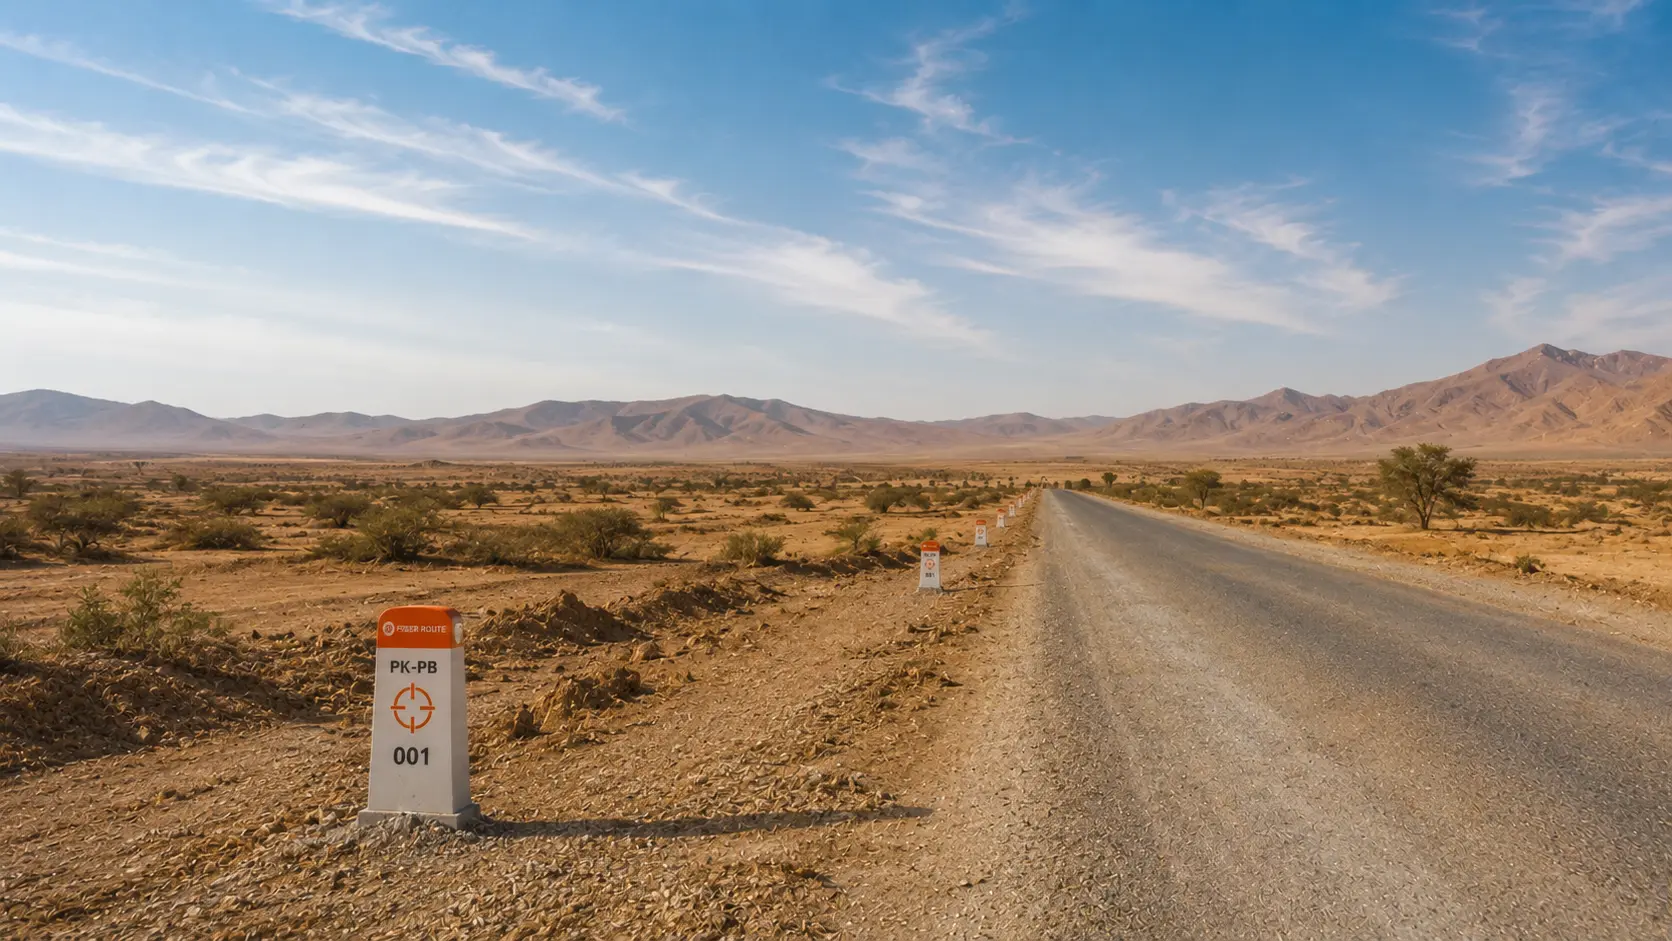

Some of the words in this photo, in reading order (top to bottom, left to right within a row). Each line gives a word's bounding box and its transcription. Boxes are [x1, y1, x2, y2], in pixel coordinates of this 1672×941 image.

[420, 625, 447, 634] ROUTE
[390, 660, 438, 674] PK-PB
[393, 746, 430, 766] 001
